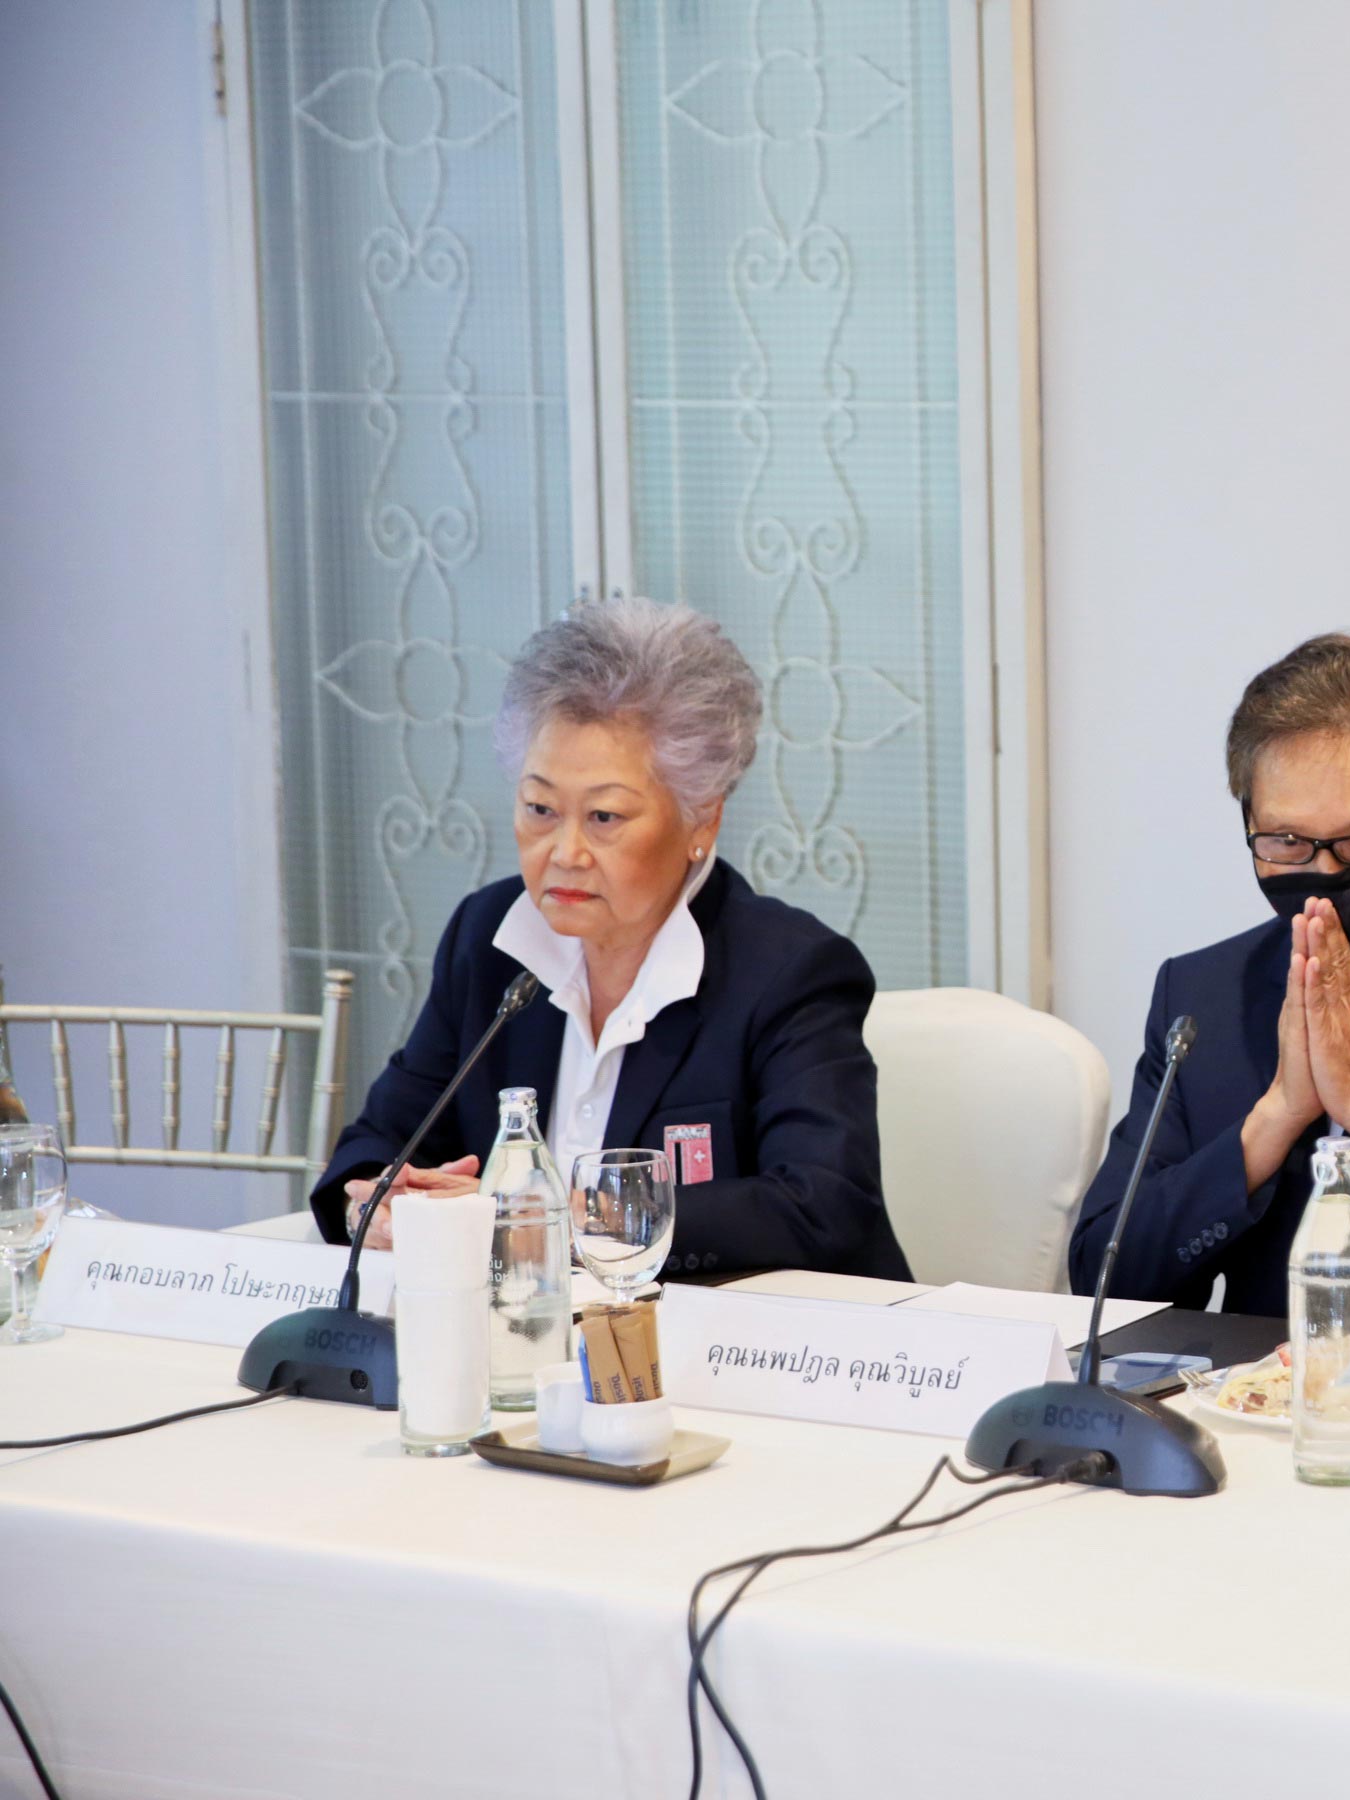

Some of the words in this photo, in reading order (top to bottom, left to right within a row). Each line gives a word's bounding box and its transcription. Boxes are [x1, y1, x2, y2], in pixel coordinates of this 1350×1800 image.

[87, 1260, 214, 1292] คุณกอบลาภ
[304, 1328, 377, 1356] BOSCH
[707, 1344, 840, 1384] คุณนพปฎล
[849, 1352, 970, 1398] คุณวิบูลย์
[1042, 1403, 1125, 1437] BOSCH
